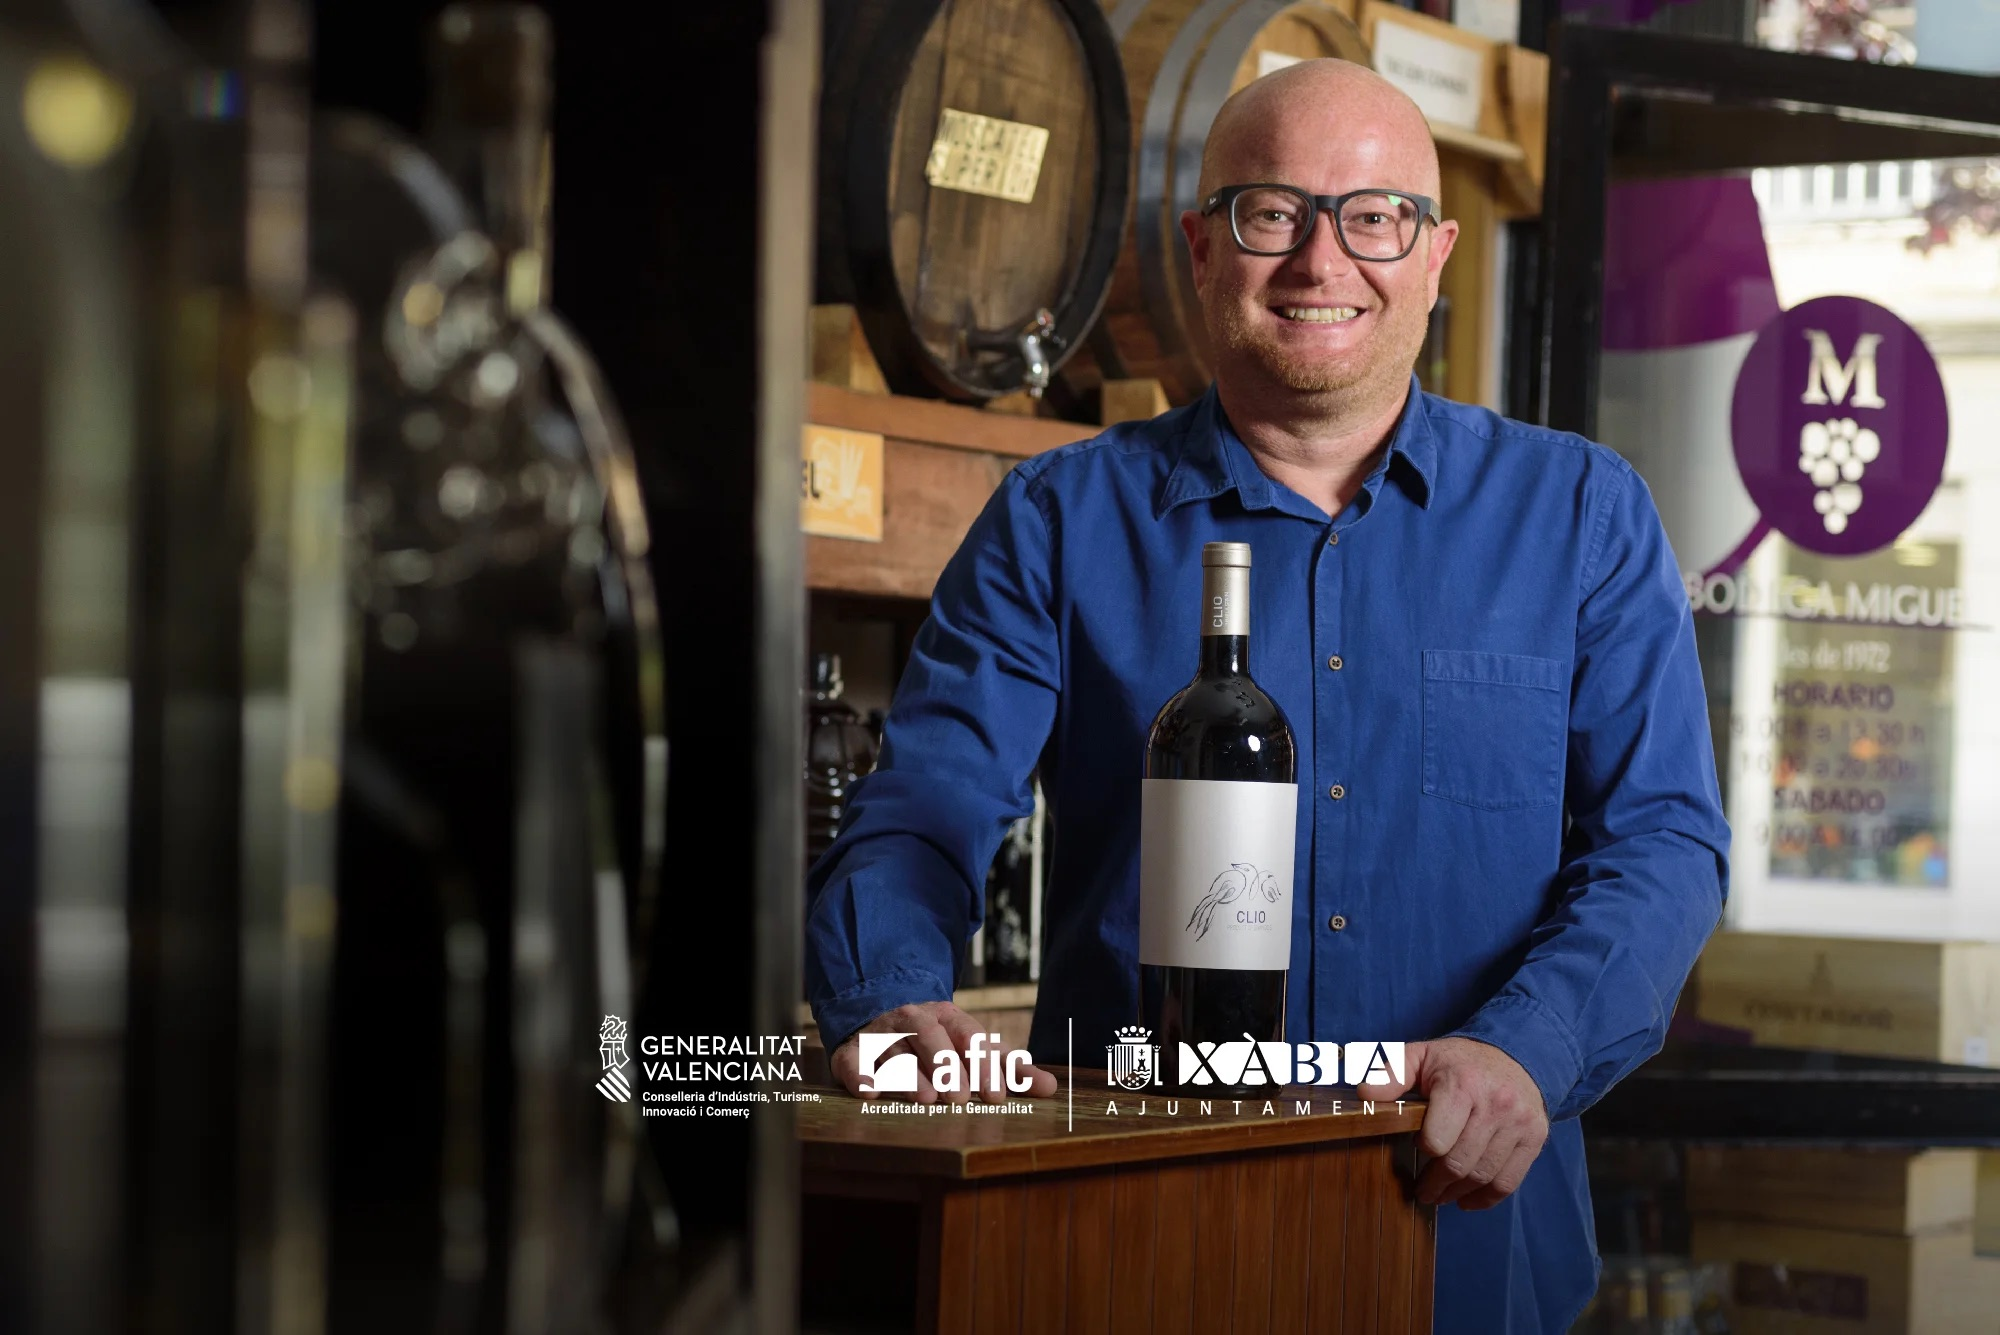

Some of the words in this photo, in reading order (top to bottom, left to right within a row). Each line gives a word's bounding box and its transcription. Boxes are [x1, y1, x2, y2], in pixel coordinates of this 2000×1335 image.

[1800, 328, 1887, 409] M
[1213, 596, 1223, 628] CLIO
[1683, 572, 1837, 620] BODGA
[1844, 580, 1975, 629] MIGUE
[1774, 681, 1895, 712] HORARIO
[1236, 910, 1266, 924] CLIO
